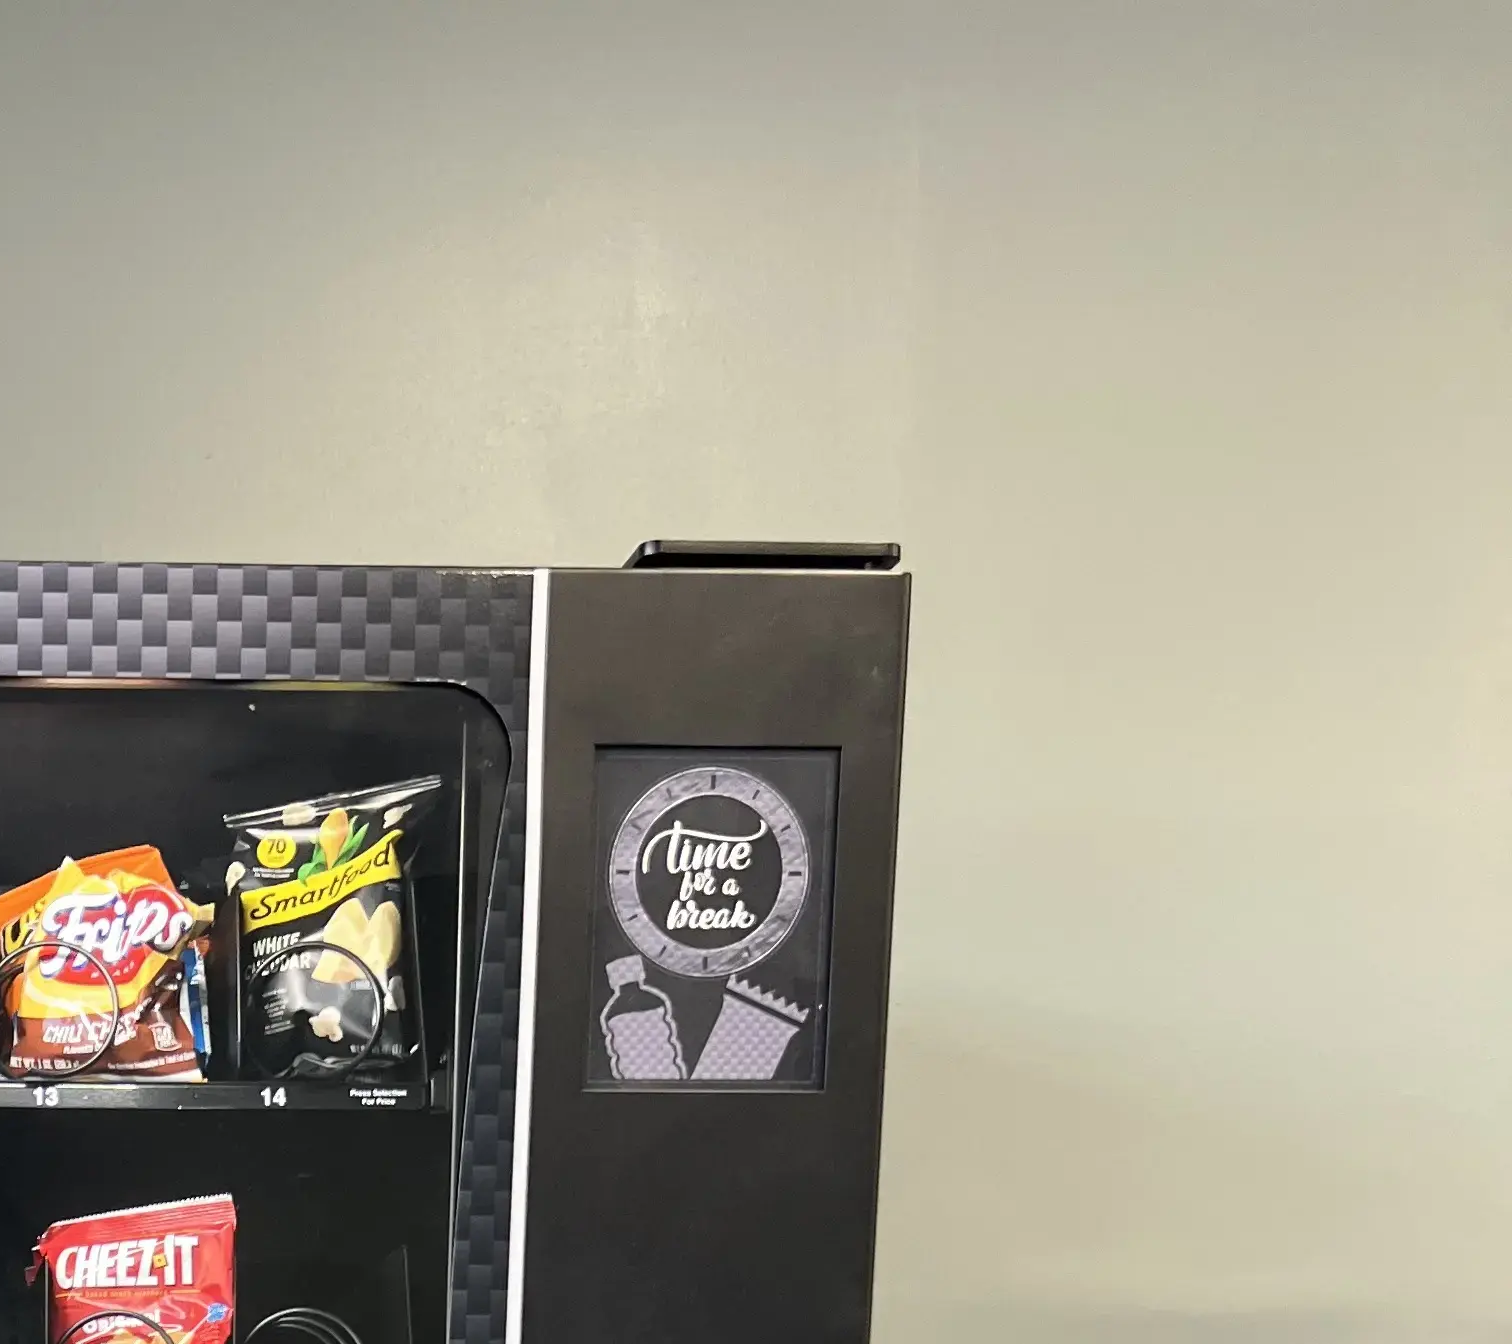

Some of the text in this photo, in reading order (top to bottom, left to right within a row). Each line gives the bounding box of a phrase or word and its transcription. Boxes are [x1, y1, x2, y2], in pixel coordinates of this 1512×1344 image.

[267, 838, 287, 854] 70
[250, 842, 394, 921] Smartfood
[679, 868, 740, 901] for a
[667, 900, 756, 930] break
[252, 931, 301, 958] WHITE
[33, 1087, 59, 1106] 13
[260, 1086, 287, 1107] 14
[361, 1098, 396, 1106] For Price
[372, 1089, 407, 1097] Selection
